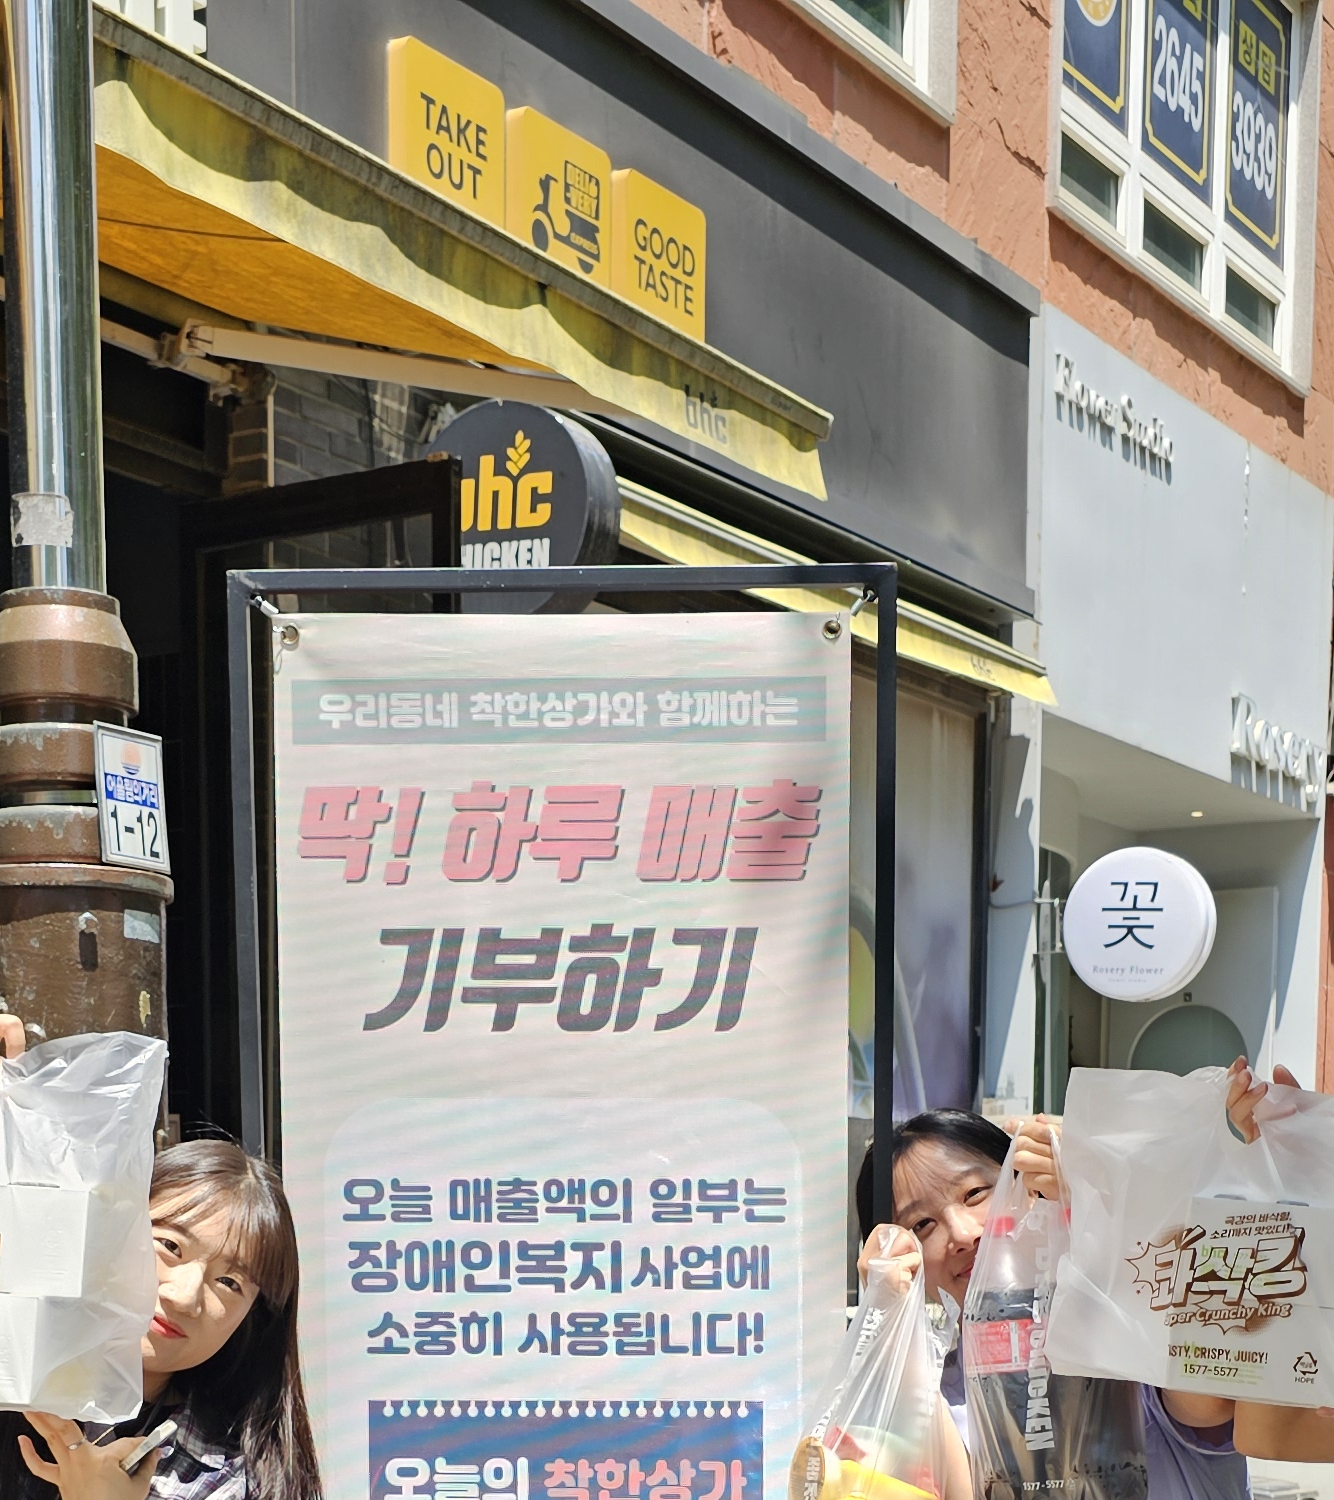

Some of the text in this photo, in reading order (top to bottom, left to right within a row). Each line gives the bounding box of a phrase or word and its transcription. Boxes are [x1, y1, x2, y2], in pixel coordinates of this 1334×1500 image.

[1153, 15, 1204, 132] 2645
[420, 92, 488, 163] TAKE
[1232, 91, 1276, 200] 3939
[426, 141, 483, 200] OUT
[634, 218, 696, 278] GOOD
[634, 255, 695, 318] TASTE
[1054, 353, 1174, 463] Flower Studio
[461, 538, 551, 568] HICKEN
[319, 690, 799, 730] 우리동네 착한상가와 함께하는
[1230, 692, 1327, 803] Rosery
[111, 804, 160, 859] 1-12
[297, 778, 824, 886] 딱! 하루 매출
[1102, 881, 1164, 950] 꽃
[362, 922, 760, 1033] 기부하기
[1092, 965, 1165, 976] Rosery Flower
[342, 1178, 787, 1224] 오늘 매출액의 일부는
[1210, 1227, 1253, 1240] 소리까지
[347, 1239, 770, 1294] 장애인복지 사업에
[367, 1311, 765, 1357] 소중히 사용됩니다!
[1194, 1306, 1256, 1323] Crunchy
[1257, 1302, 1294, 1318] King
[1183, 1363, 1239, 1378] 1577-5577
[1194, 1347, 1232, 1363] CRISPY,
[1234, 1350, 1269, 1365] JUICY!
[1022, 1479, 1065, 1492] 1577-5577
